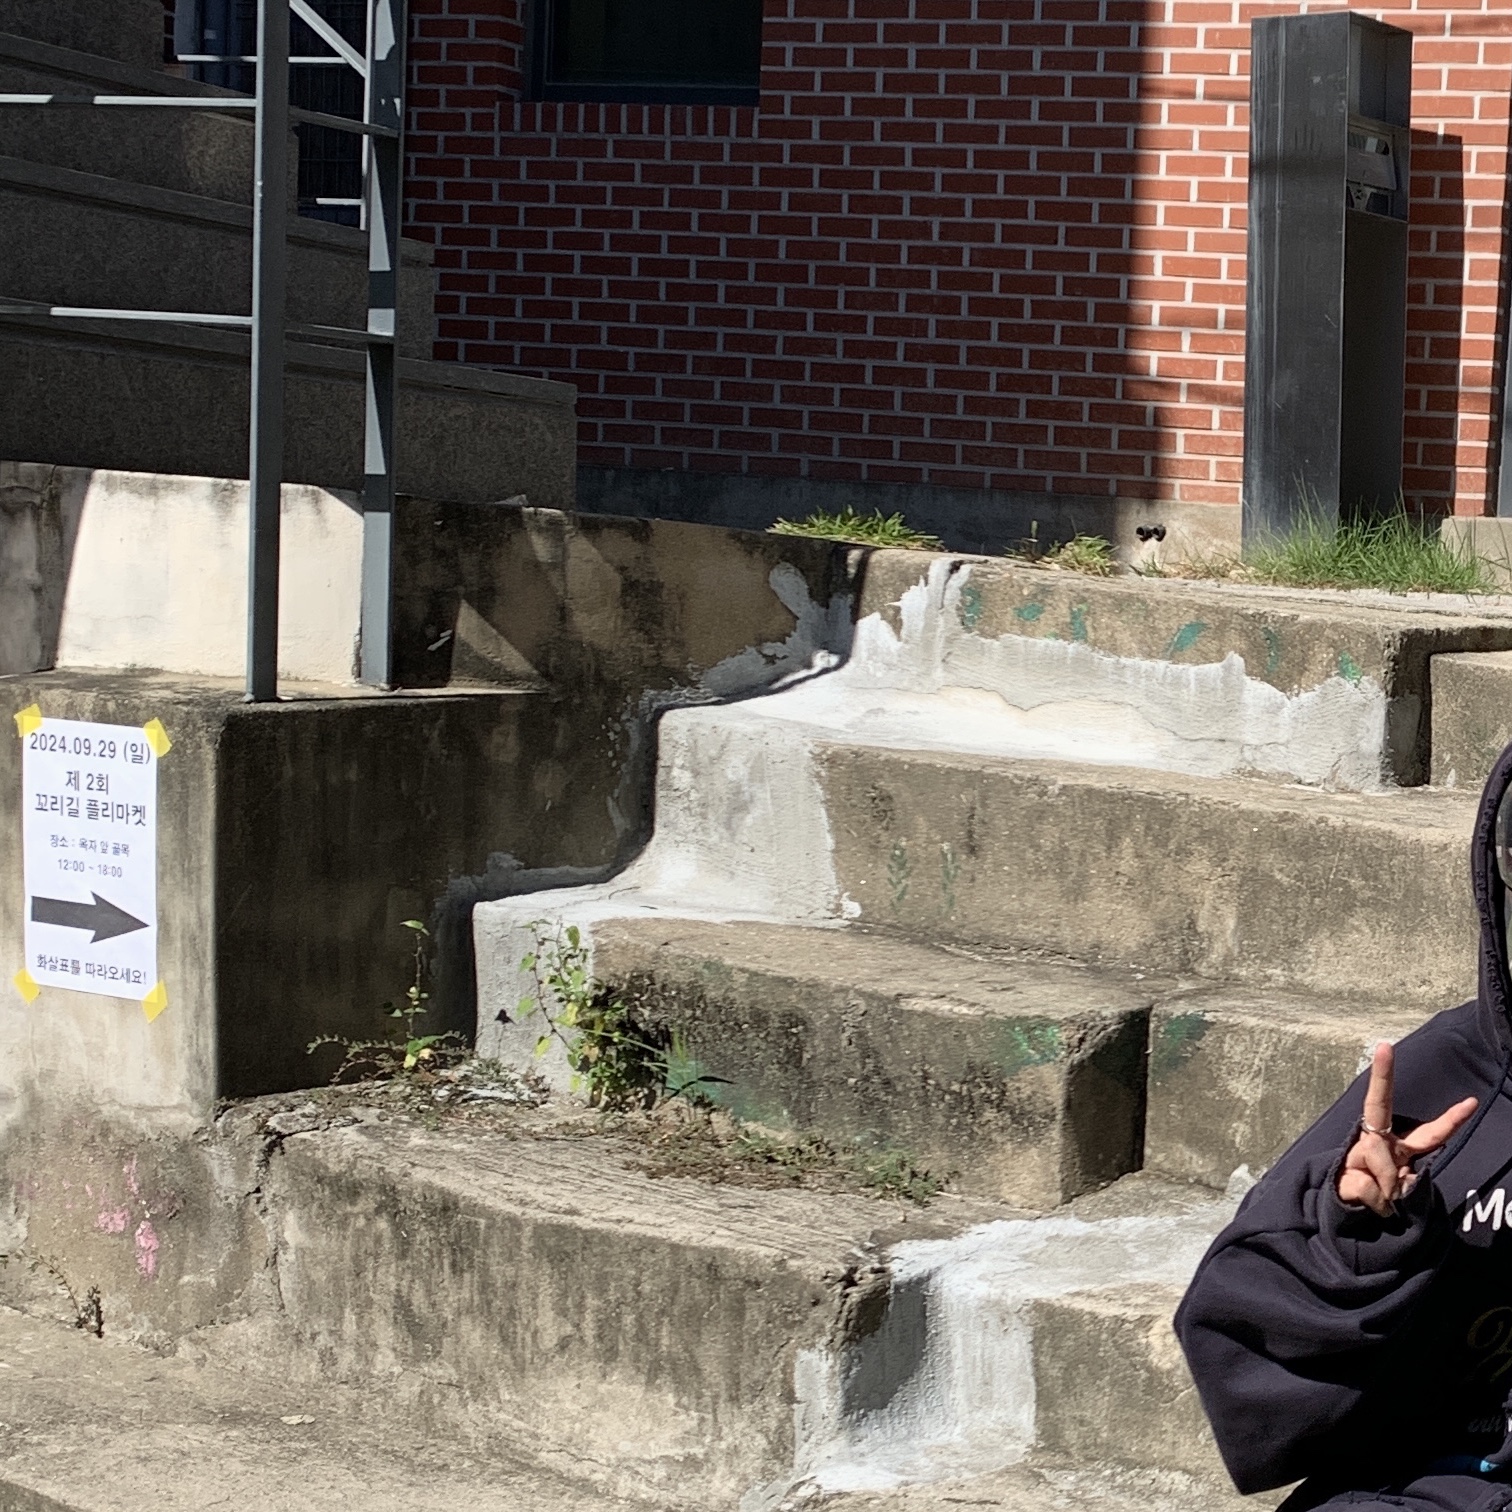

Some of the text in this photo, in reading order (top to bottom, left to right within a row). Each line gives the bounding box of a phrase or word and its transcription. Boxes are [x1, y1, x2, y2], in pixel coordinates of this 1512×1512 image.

[30, 732, 151, 764] 2024.09.29 (일)
[65, 770, 109, 795] 제 2회
[35, 793, 146, 827] 꼬리길 플리마켓
[50, 834, 69, 848] 장소
[100, 840, 109, 855] 앞
[112, 842, 130, 857] 골목
[57, 859, 85, 873] 12:00
[98, 864, 123, 878] 18:00
[37, 954, 147, 985] 화살표를 따라오세요!
